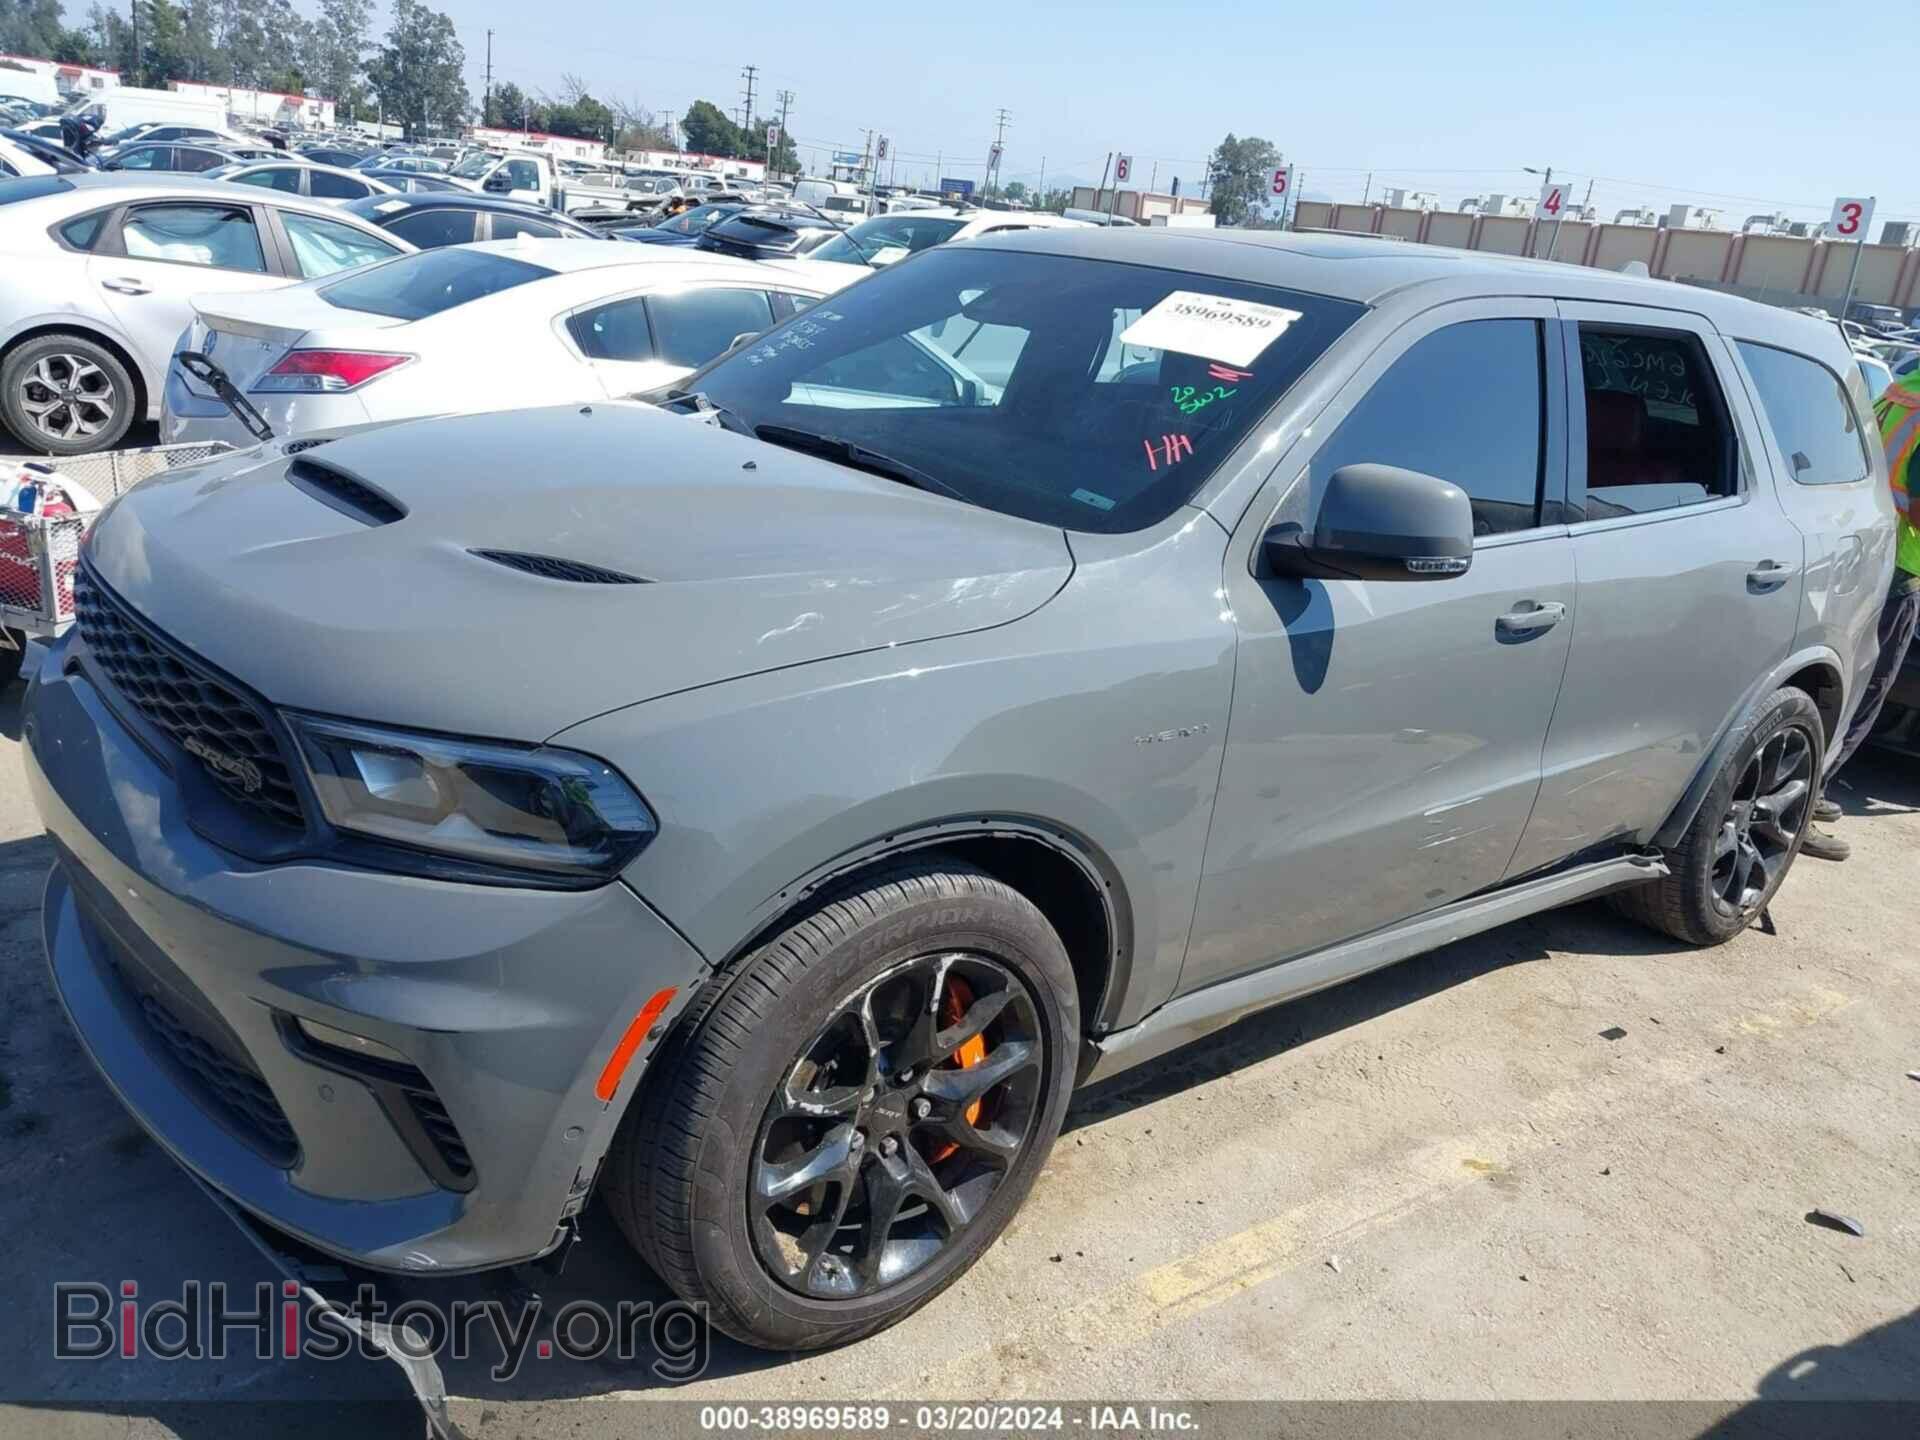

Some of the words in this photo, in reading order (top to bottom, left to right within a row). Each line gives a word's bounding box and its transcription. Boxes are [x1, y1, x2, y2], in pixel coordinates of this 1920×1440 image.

[768, 128, 776, 145] 9
[878, 140, 886, 158] 8
[1117, 158, 1128, 180] 6
[1272, 170, 1287, 194] 5
[1543, 188, 1561, 216] 4
[1837, 203, 1863, 235] 3
[1173, 303, 1272, 329] 38969589
